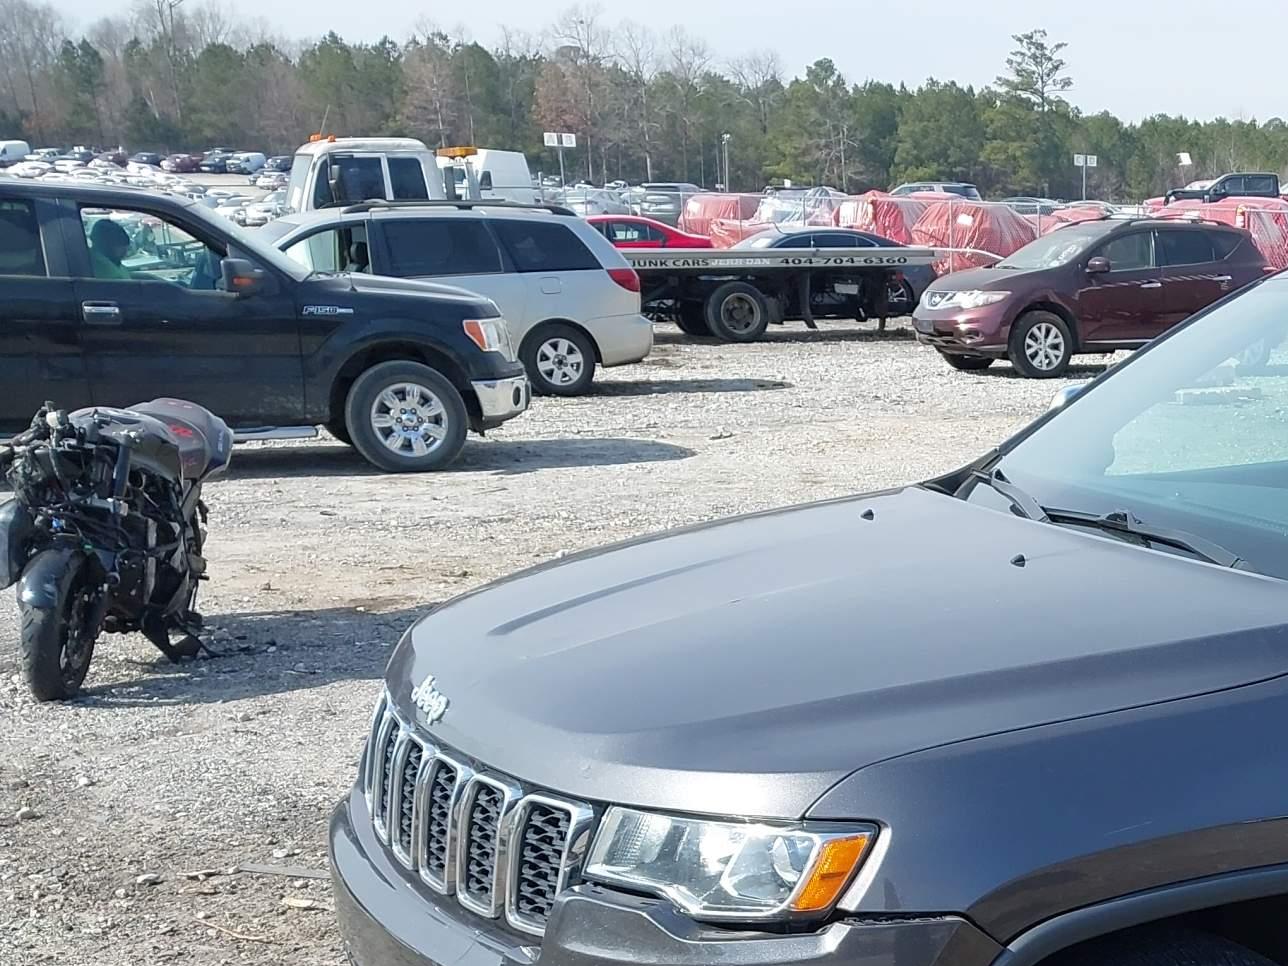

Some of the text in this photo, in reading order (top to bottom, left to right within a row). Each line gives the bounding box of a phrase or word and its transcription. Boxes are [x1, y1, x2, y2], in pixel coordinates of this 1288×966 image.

[632, 259, 710, 267] JUNK CARS
[780, 256, 908, 265] 404-704-6360
[411, 674, 449, 725] Jeep
